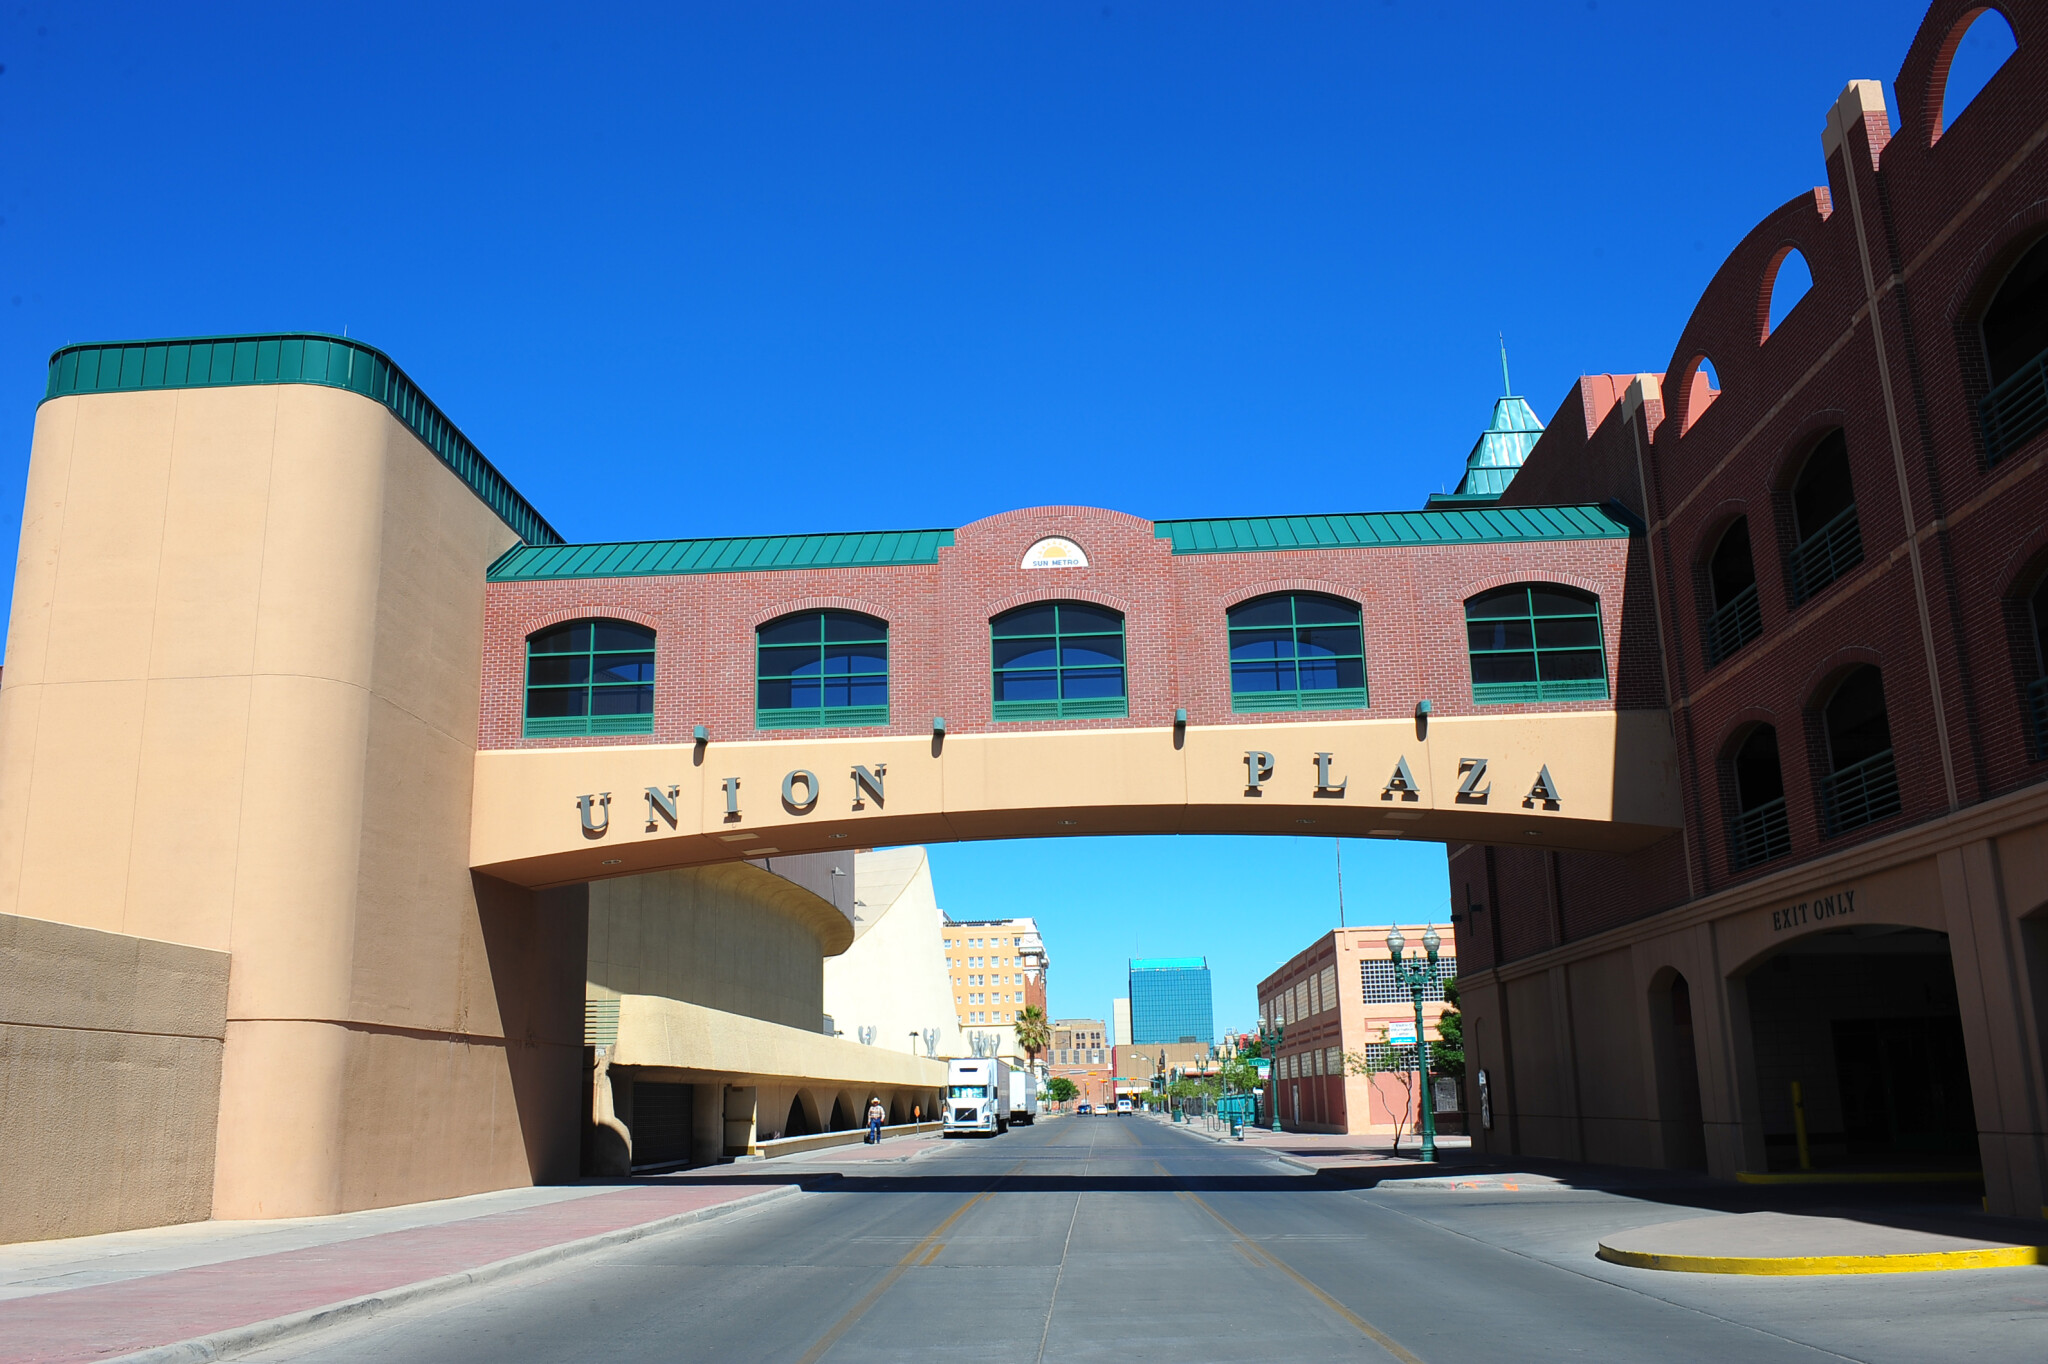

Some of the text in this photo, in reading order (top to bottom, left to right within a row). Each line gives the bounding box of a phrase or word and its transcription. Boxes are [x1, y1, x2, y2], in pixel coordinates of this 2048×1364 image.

[576, 750, 1562, 830] UNION PLAZA
[1772, 890, 1856, 931] EXIT ONLY
